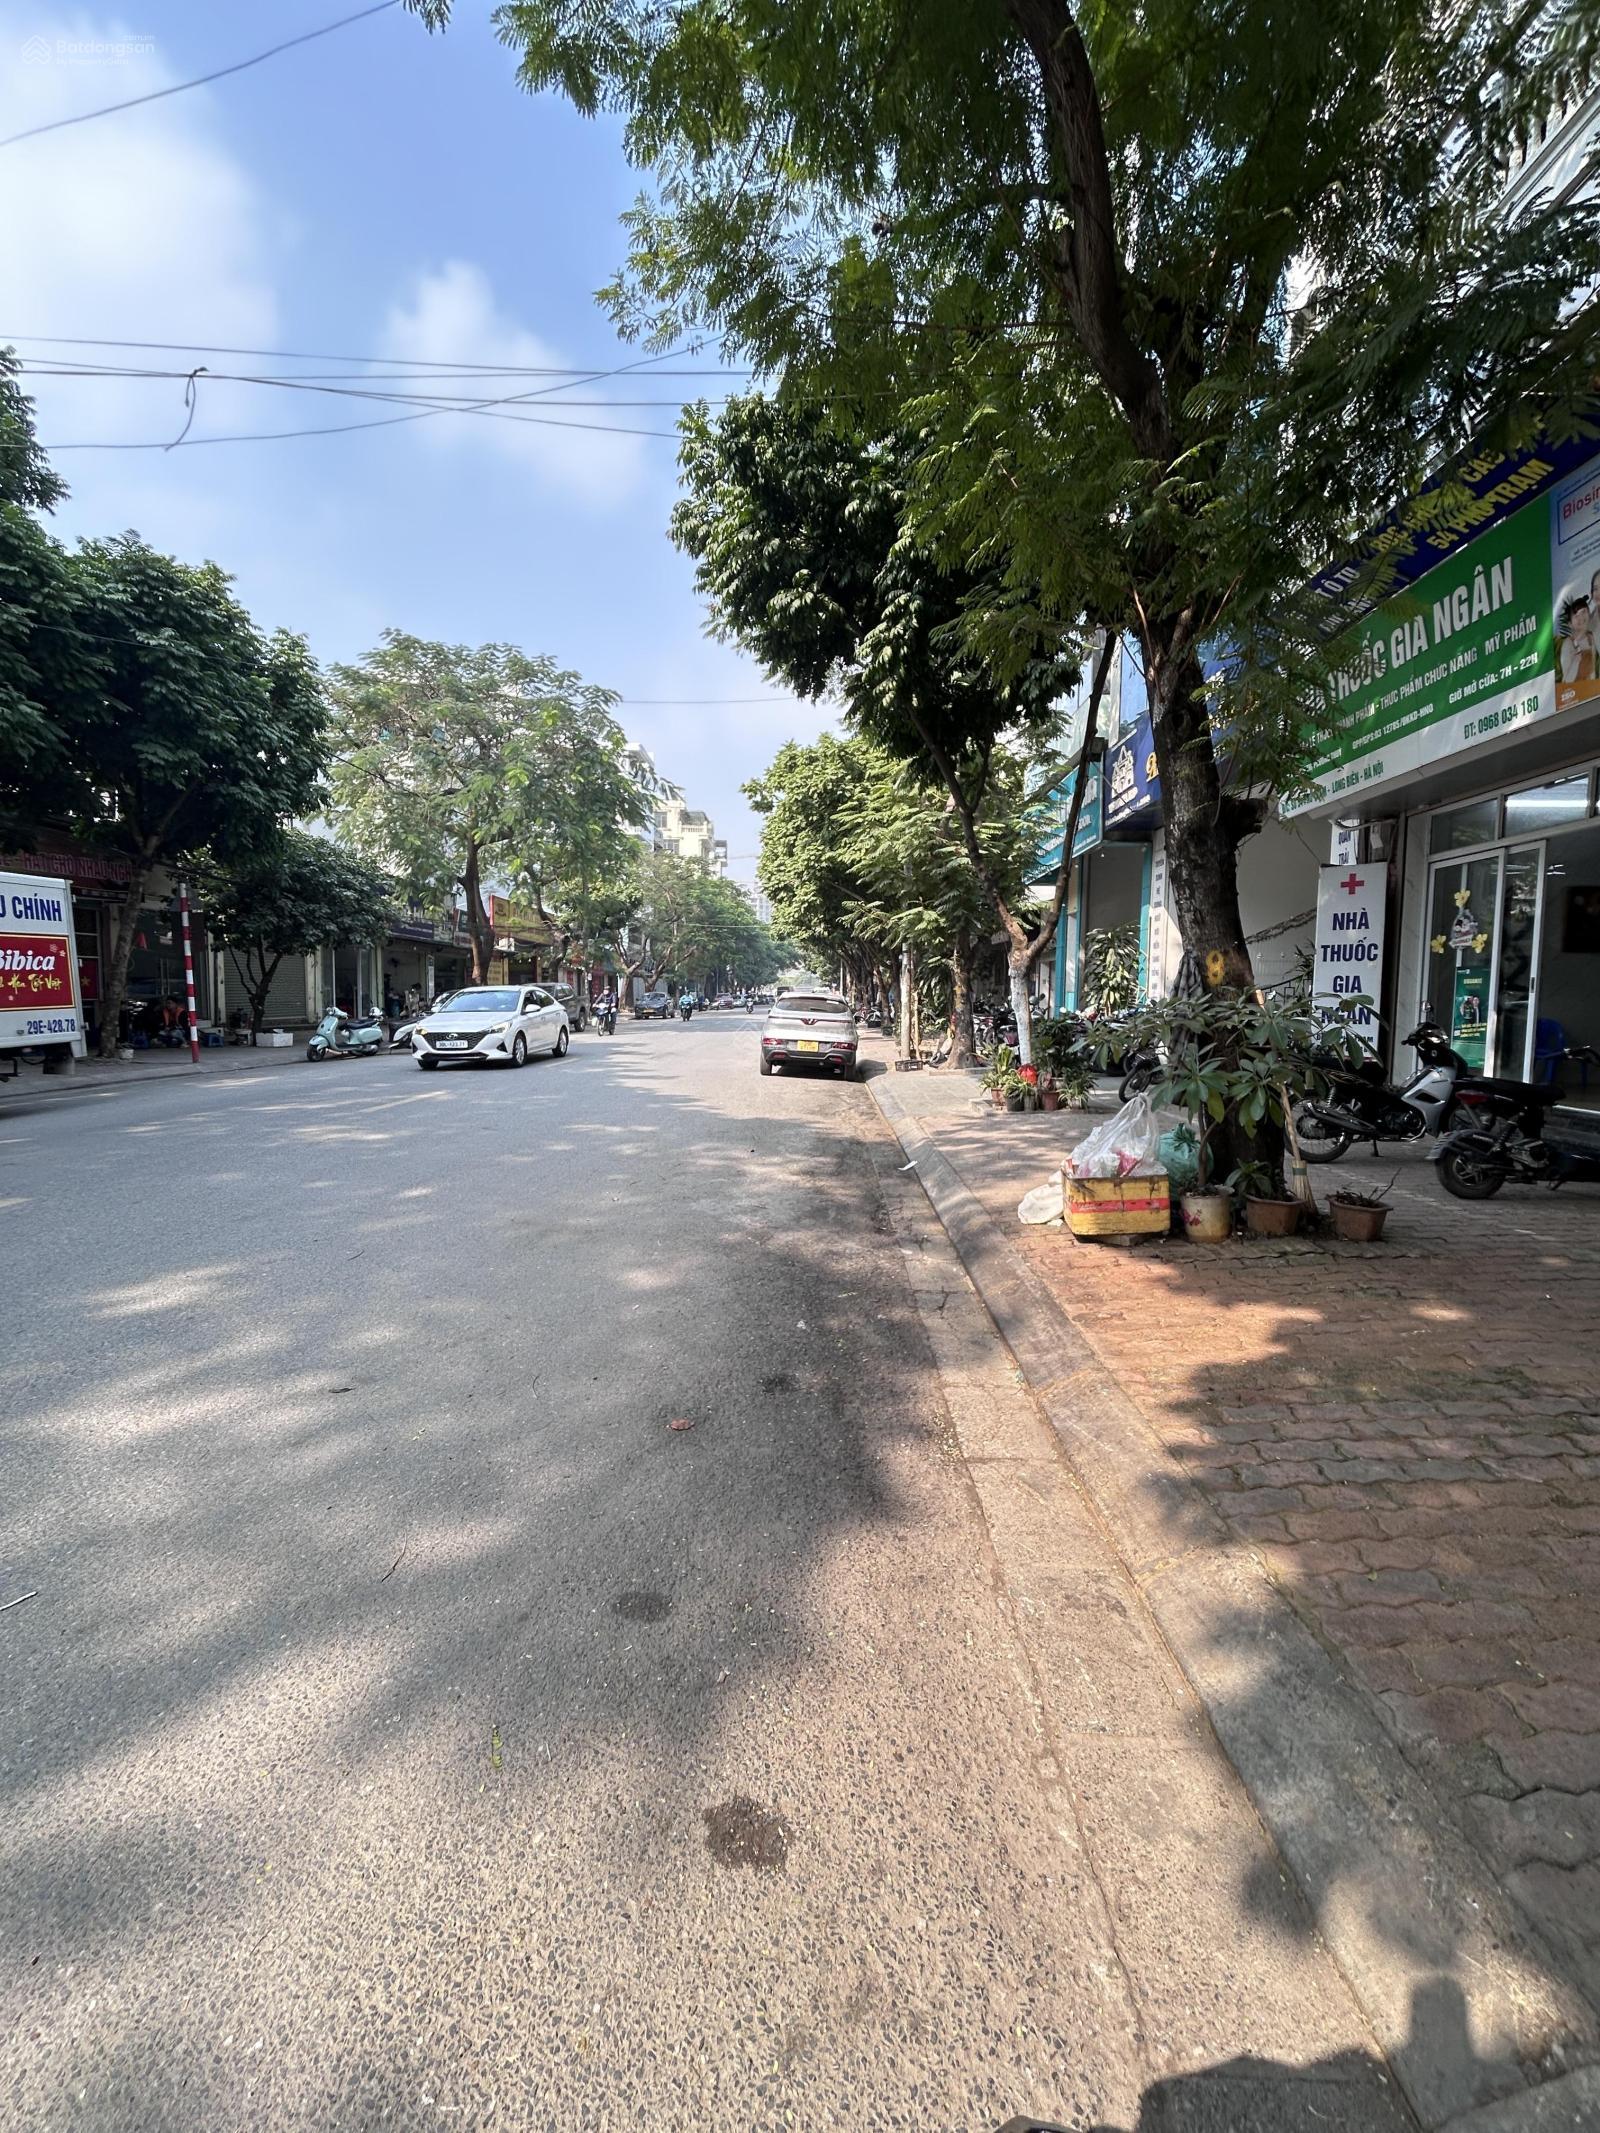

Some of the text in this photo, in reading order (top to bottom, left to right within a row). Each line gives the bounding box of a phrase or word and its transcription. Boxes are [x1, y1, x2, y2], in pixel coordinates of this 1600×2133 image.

[1426, 529, 1460, 550] 54
[1390, 615, 1429, 669] GIA
[1433, 556, 1513, 643] NGÂN
[1504, 612, 1537, 645] PHẨM
[1449, 689, 1463, 704] GIỜ
[1464, 680, 1477, 696] MỞ
[1478, 672, 1499, 689] CỬA:
[1500, 666, 1511, 680] 7H
[1519, 651, 1538, 669] 22H
[1478, 711, 1499, 734] 0968
[1501, 704, 1518, 724] 034
[1521, 694, 1538, 716] 180
[1331, 777, 1346, 793] LONG
[1346, 769, 1358, 787] BIÊN
[1364, 763, 1371, 779] HÀ
[1373, 759, 1383, 778] NỘI
[11, 893, 62, 922] CHÍNH
[1332, 907, 1370, 931] NHÀ
[1321, 937, 1379, 962] THUỐC
[1332, 975, 1363, 993] GIA
[27, 1019, 76, 1035] 29E-428.78
